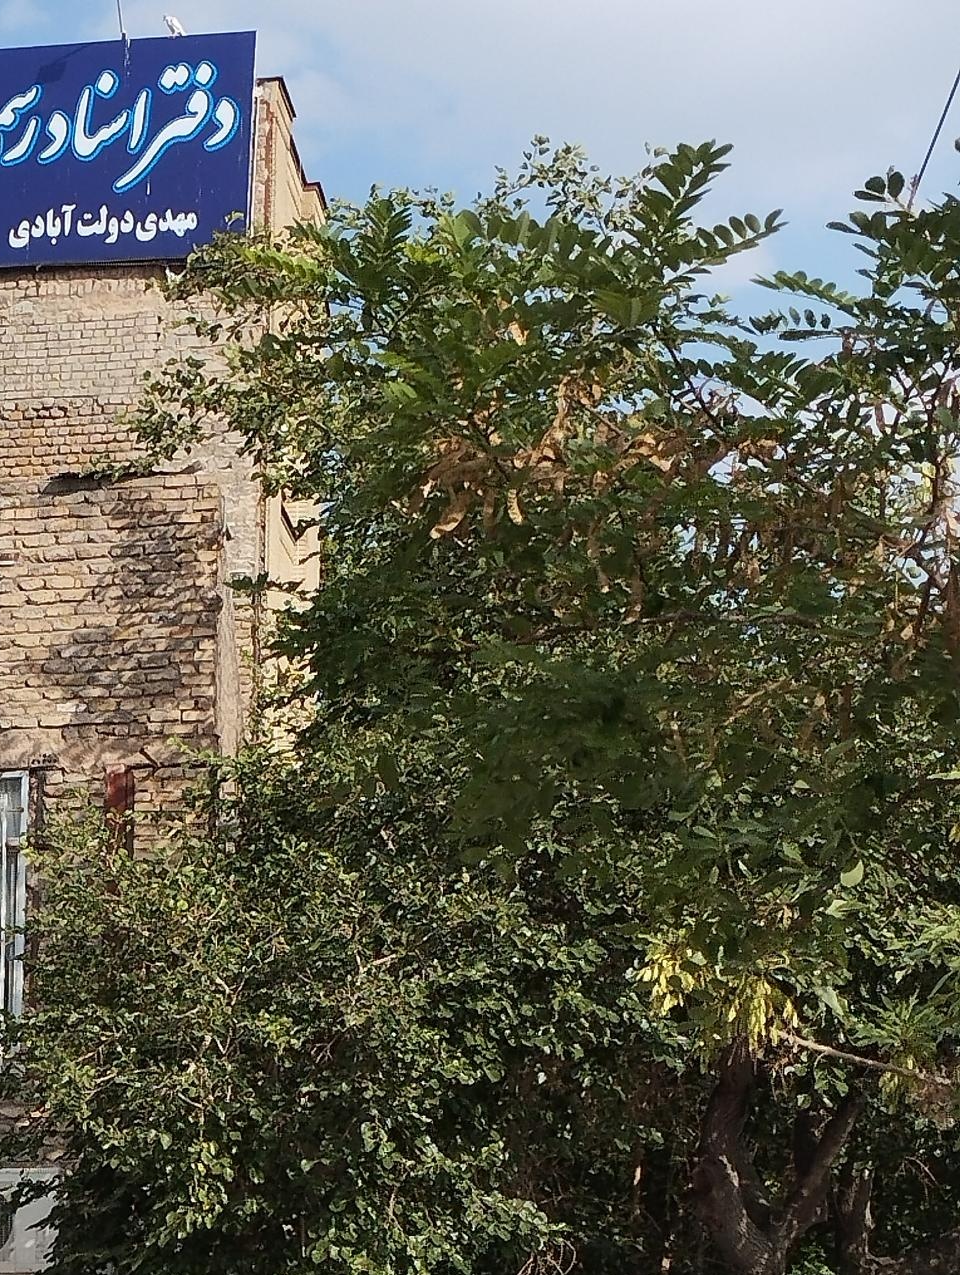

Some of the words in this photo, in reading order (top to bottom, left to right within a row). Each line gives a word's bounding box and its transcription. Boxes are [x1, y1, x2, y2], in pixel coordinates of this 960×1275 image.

[38, 70, 150, 164] اسناد
[114, 61, 238, 191] دفتر
[8, 204, 75, 248] آبادی
[77, 205, 133, 244] دولت
[136, 209, 197, 241] مهدی
